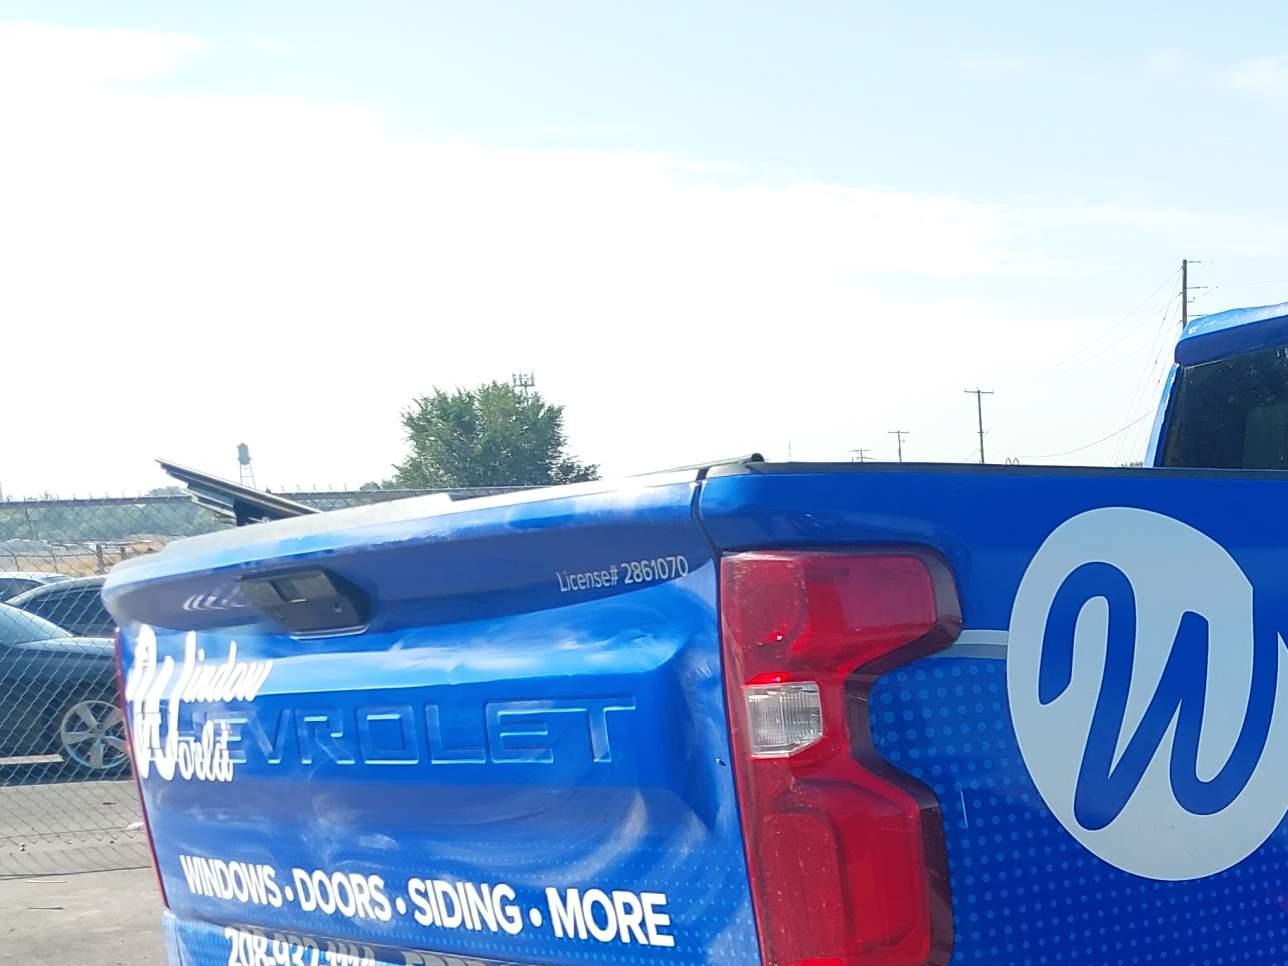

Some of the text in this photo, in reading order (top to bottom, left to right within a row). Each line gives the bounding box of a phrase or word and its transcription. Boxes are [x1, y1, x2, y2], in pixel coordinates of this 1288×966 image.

[556, 555, 689, 592] License# 2861070
[125, 624, 273, 780] Window
[179, 854, 675, 947] WINDOWS DOORS SIDING MORE
